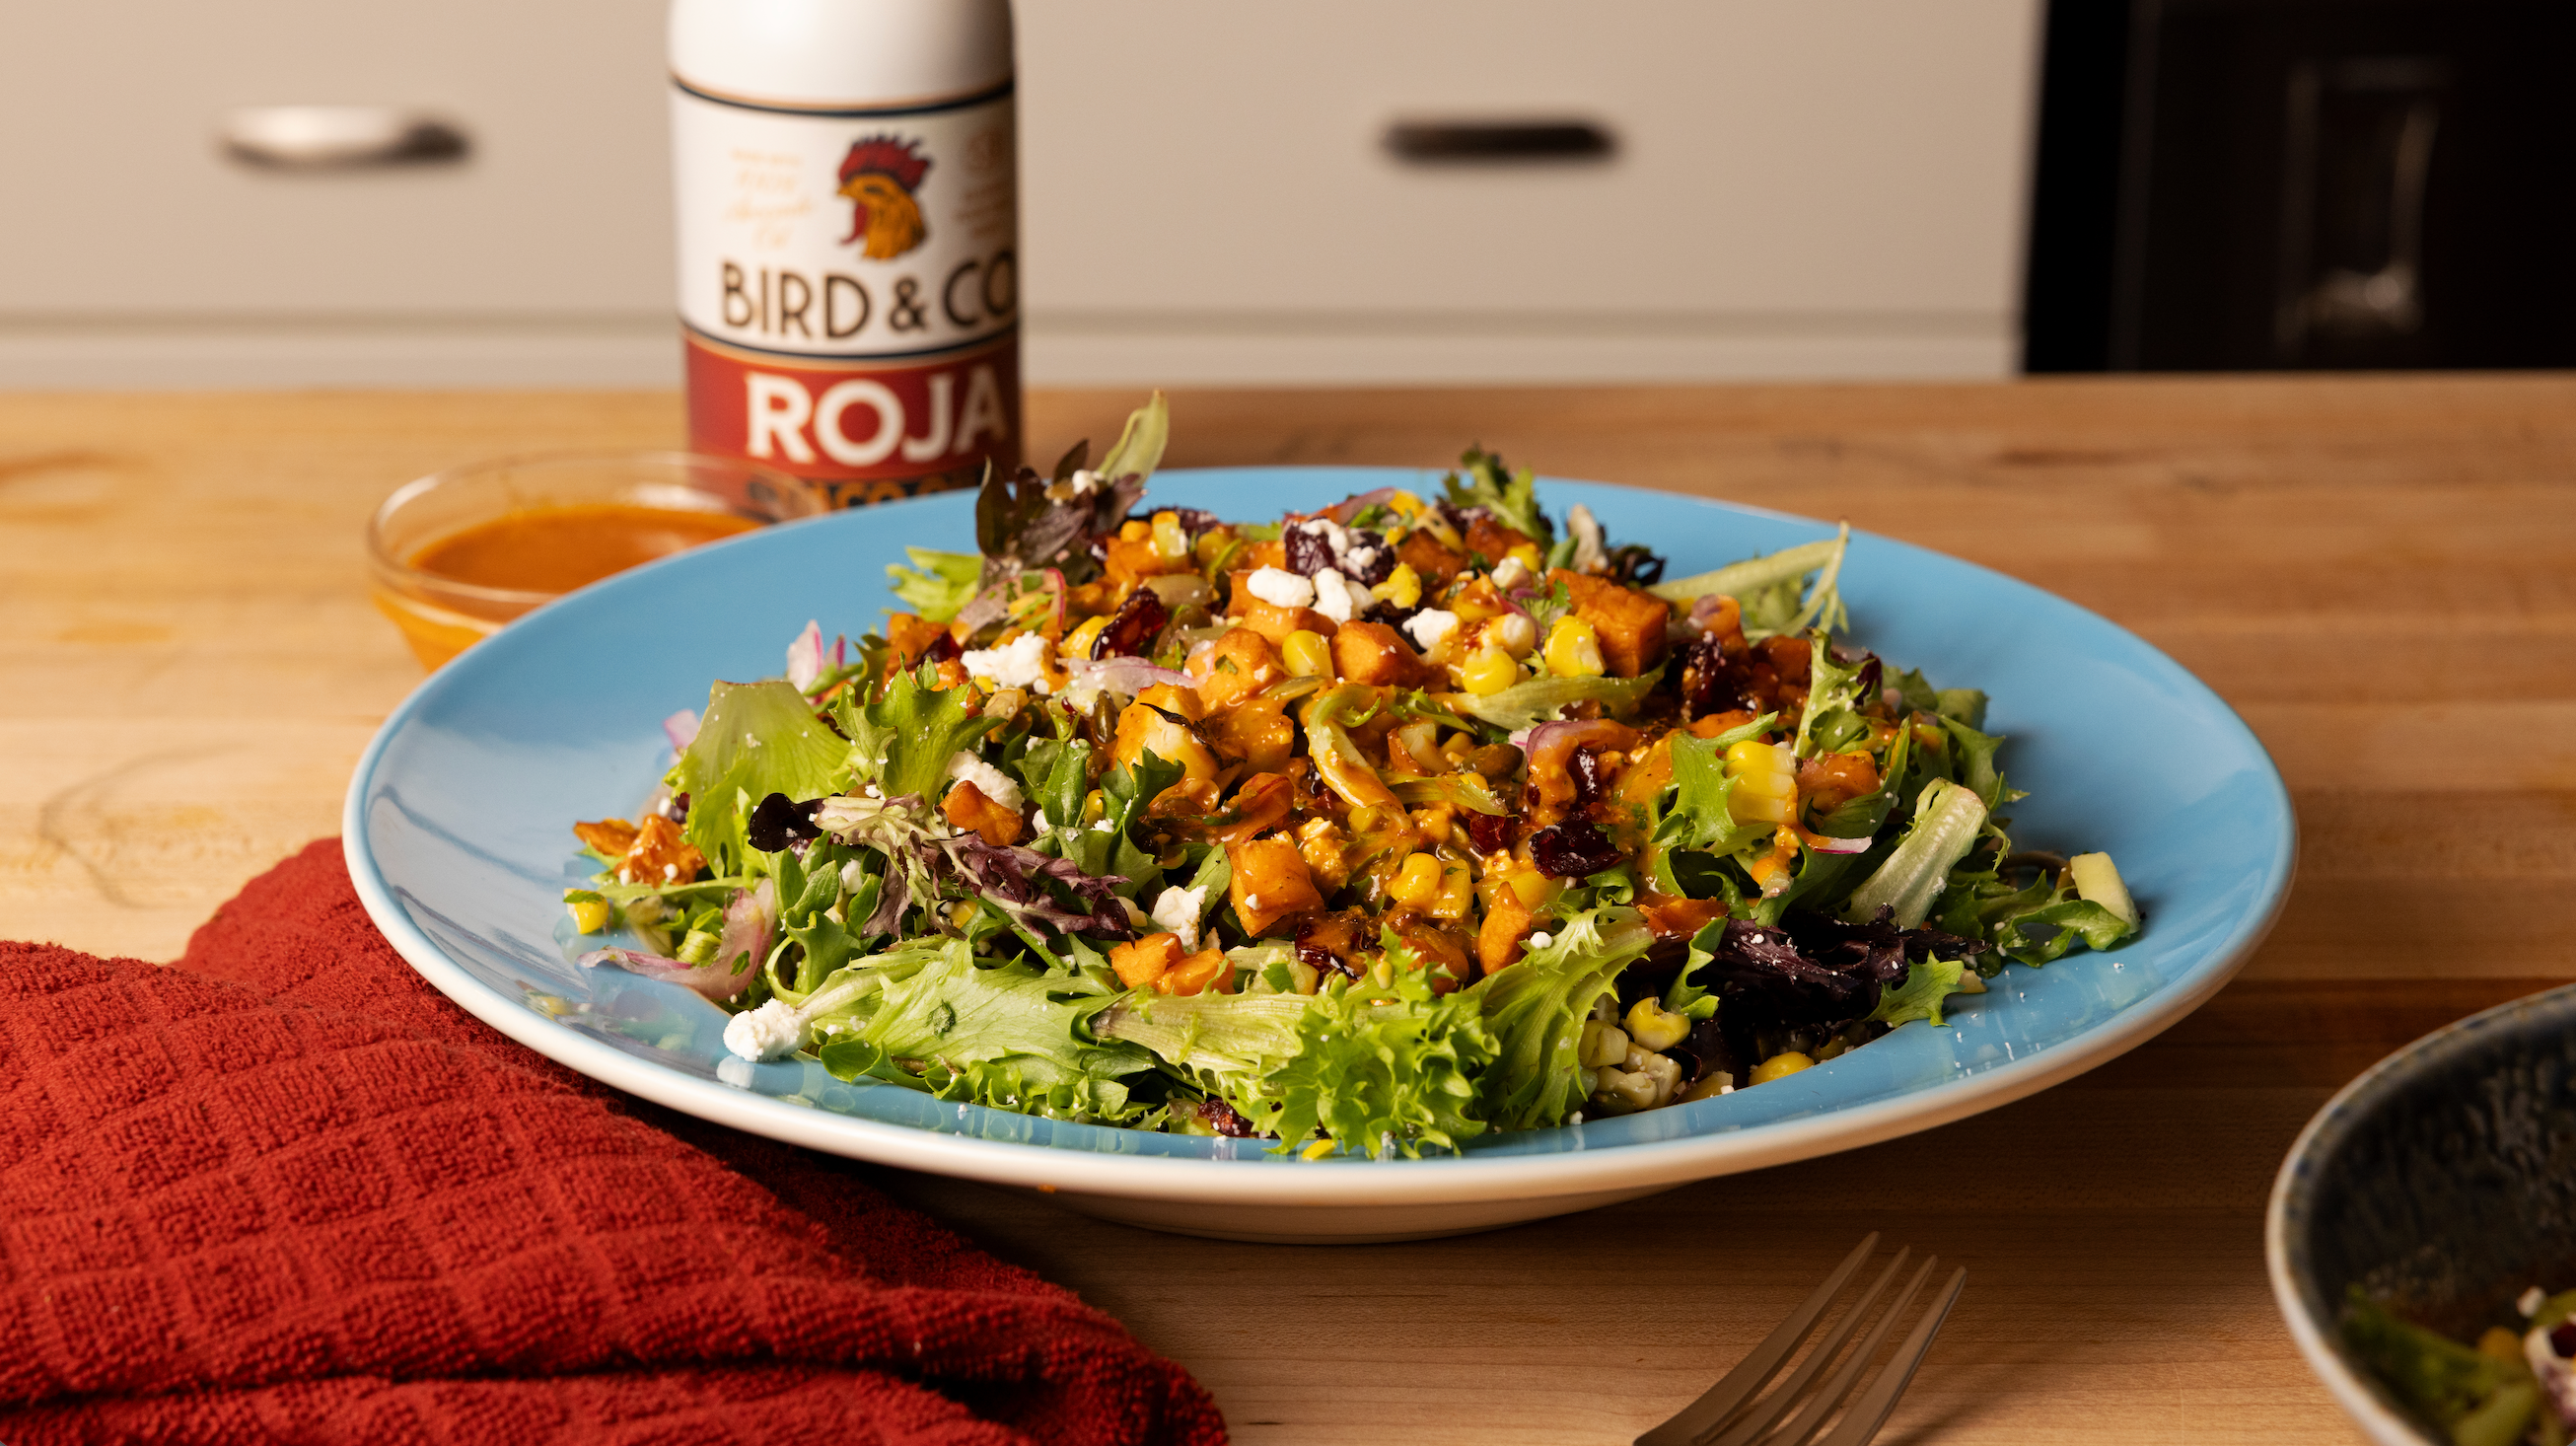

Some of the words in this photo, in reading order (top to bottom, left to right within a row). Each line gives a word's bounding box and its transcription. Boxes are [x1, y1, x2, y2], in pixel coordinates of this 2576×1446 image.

[721, 260, 872, 338] BIRD
[890, 276, 925, 332] &
[746, 363, 1007, 467] ROJA
